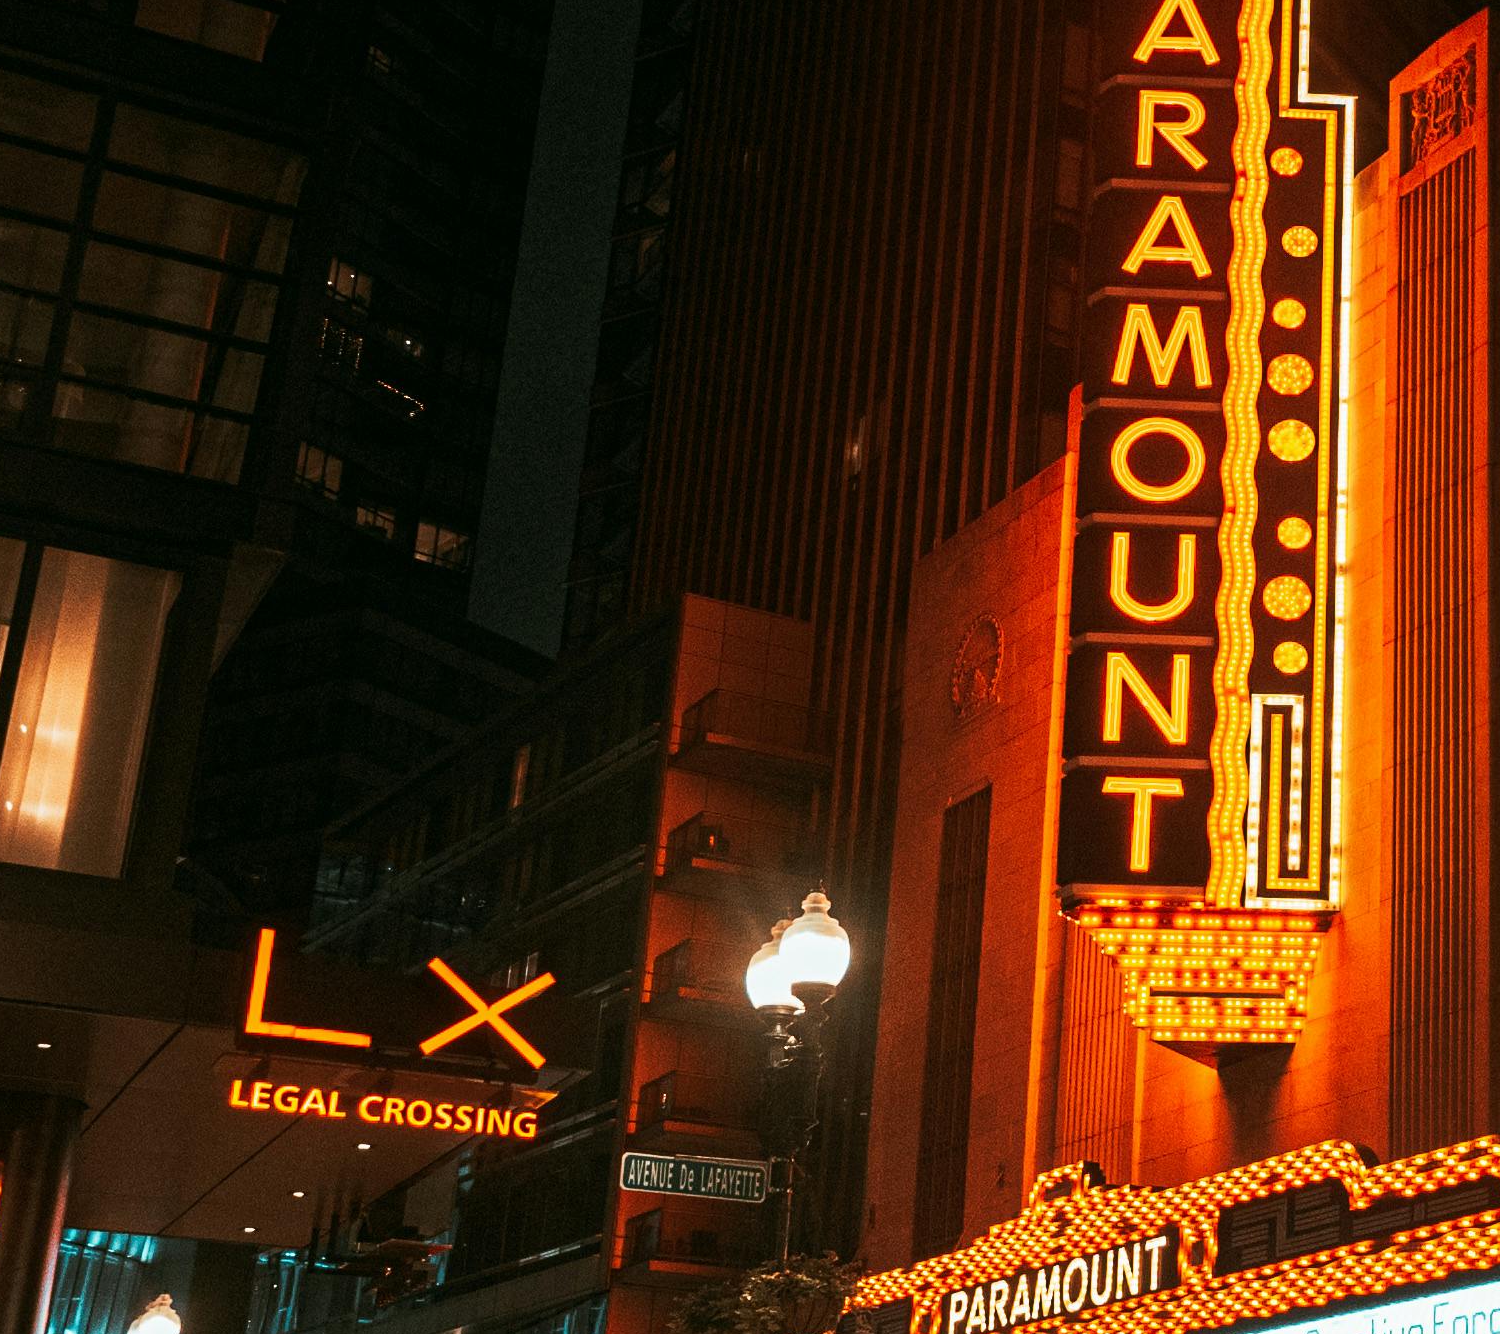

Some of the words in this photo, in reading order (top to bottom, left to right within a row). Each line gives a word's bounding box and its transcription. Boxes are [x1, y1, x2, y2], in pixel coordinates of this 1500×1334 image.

[229, 1079, 347, 1118] LEGAL
[358, 1094, 538, 1139] CROSSING
[627, 1158, 674, 1189] AVENUE
[679, 1163, 694, 1191] De
[700, 1166, 761, 1198] LAFAYETTE
